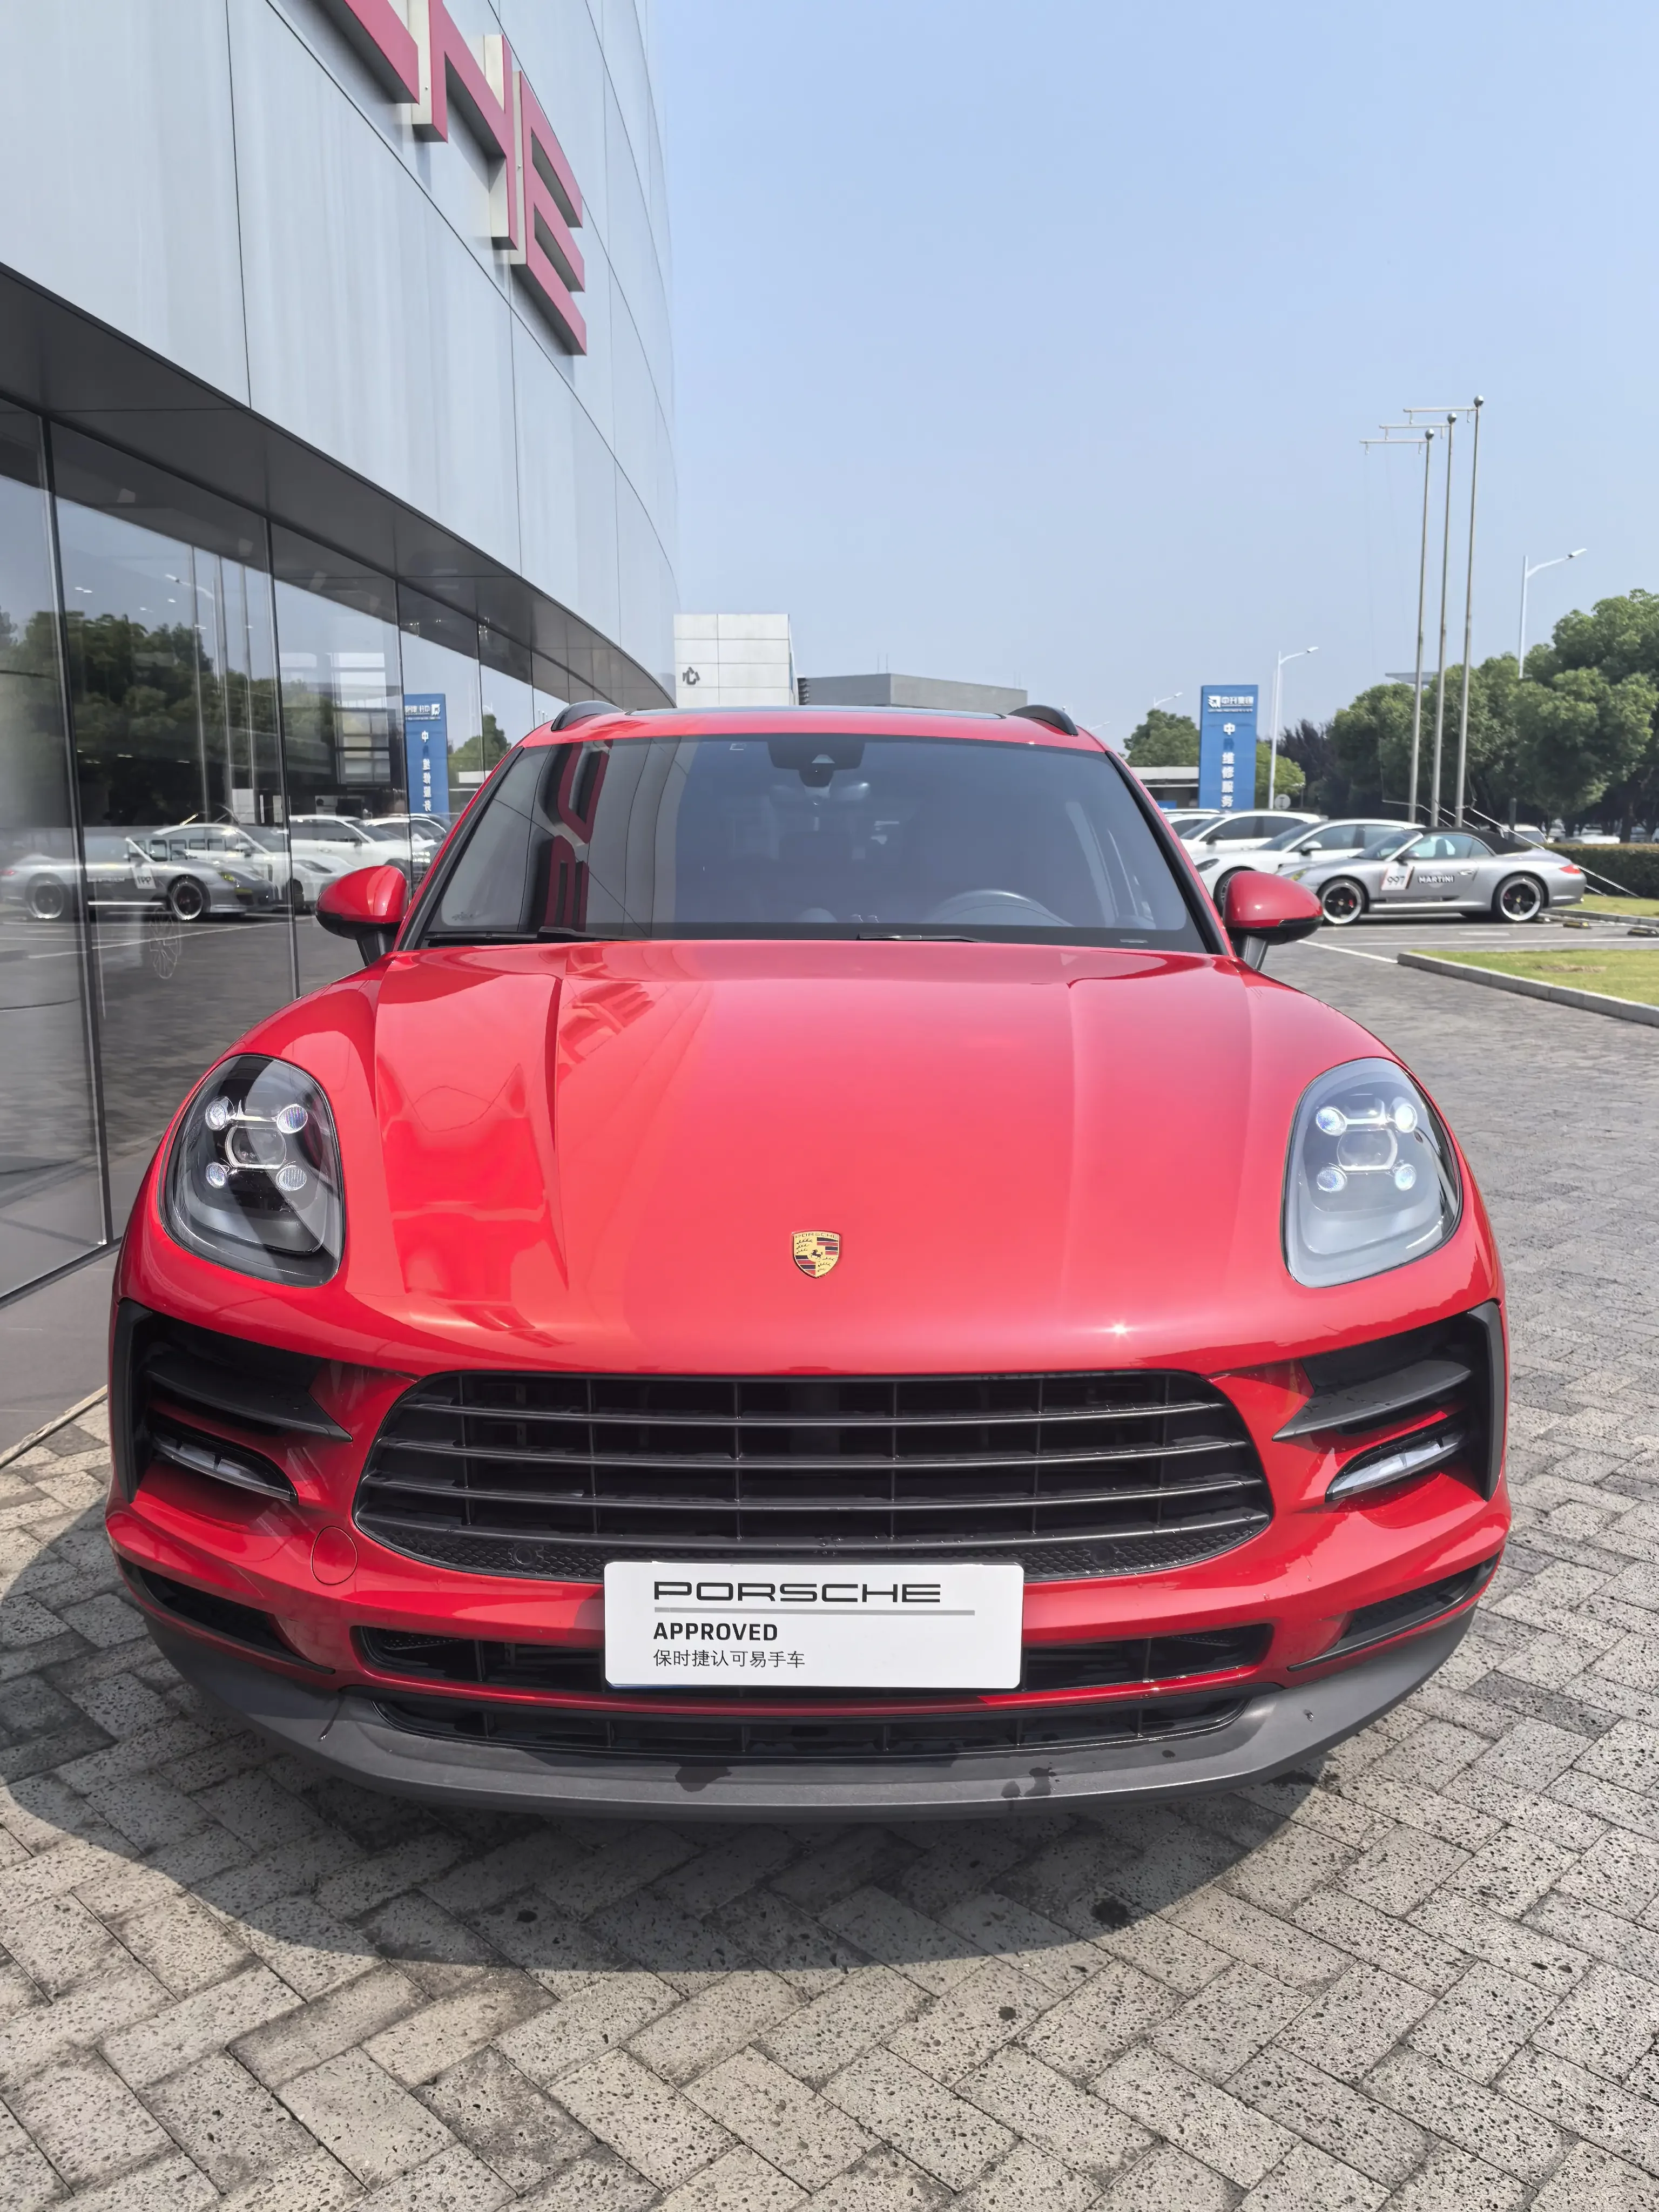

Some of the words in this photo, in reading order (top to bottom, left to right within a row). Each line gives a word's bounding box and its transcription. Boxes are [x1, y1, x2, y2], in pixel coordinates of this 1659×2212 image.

[1387, 876, 1405, 885] 997
[1418, 875, 1454, 884] MARTINI
[654, 1581, 941, 1603] PORSCHE
[653, 1622, 778, 1641] APPROVED
[653, 1649, 805, 1668] 保时捷认可易手车
